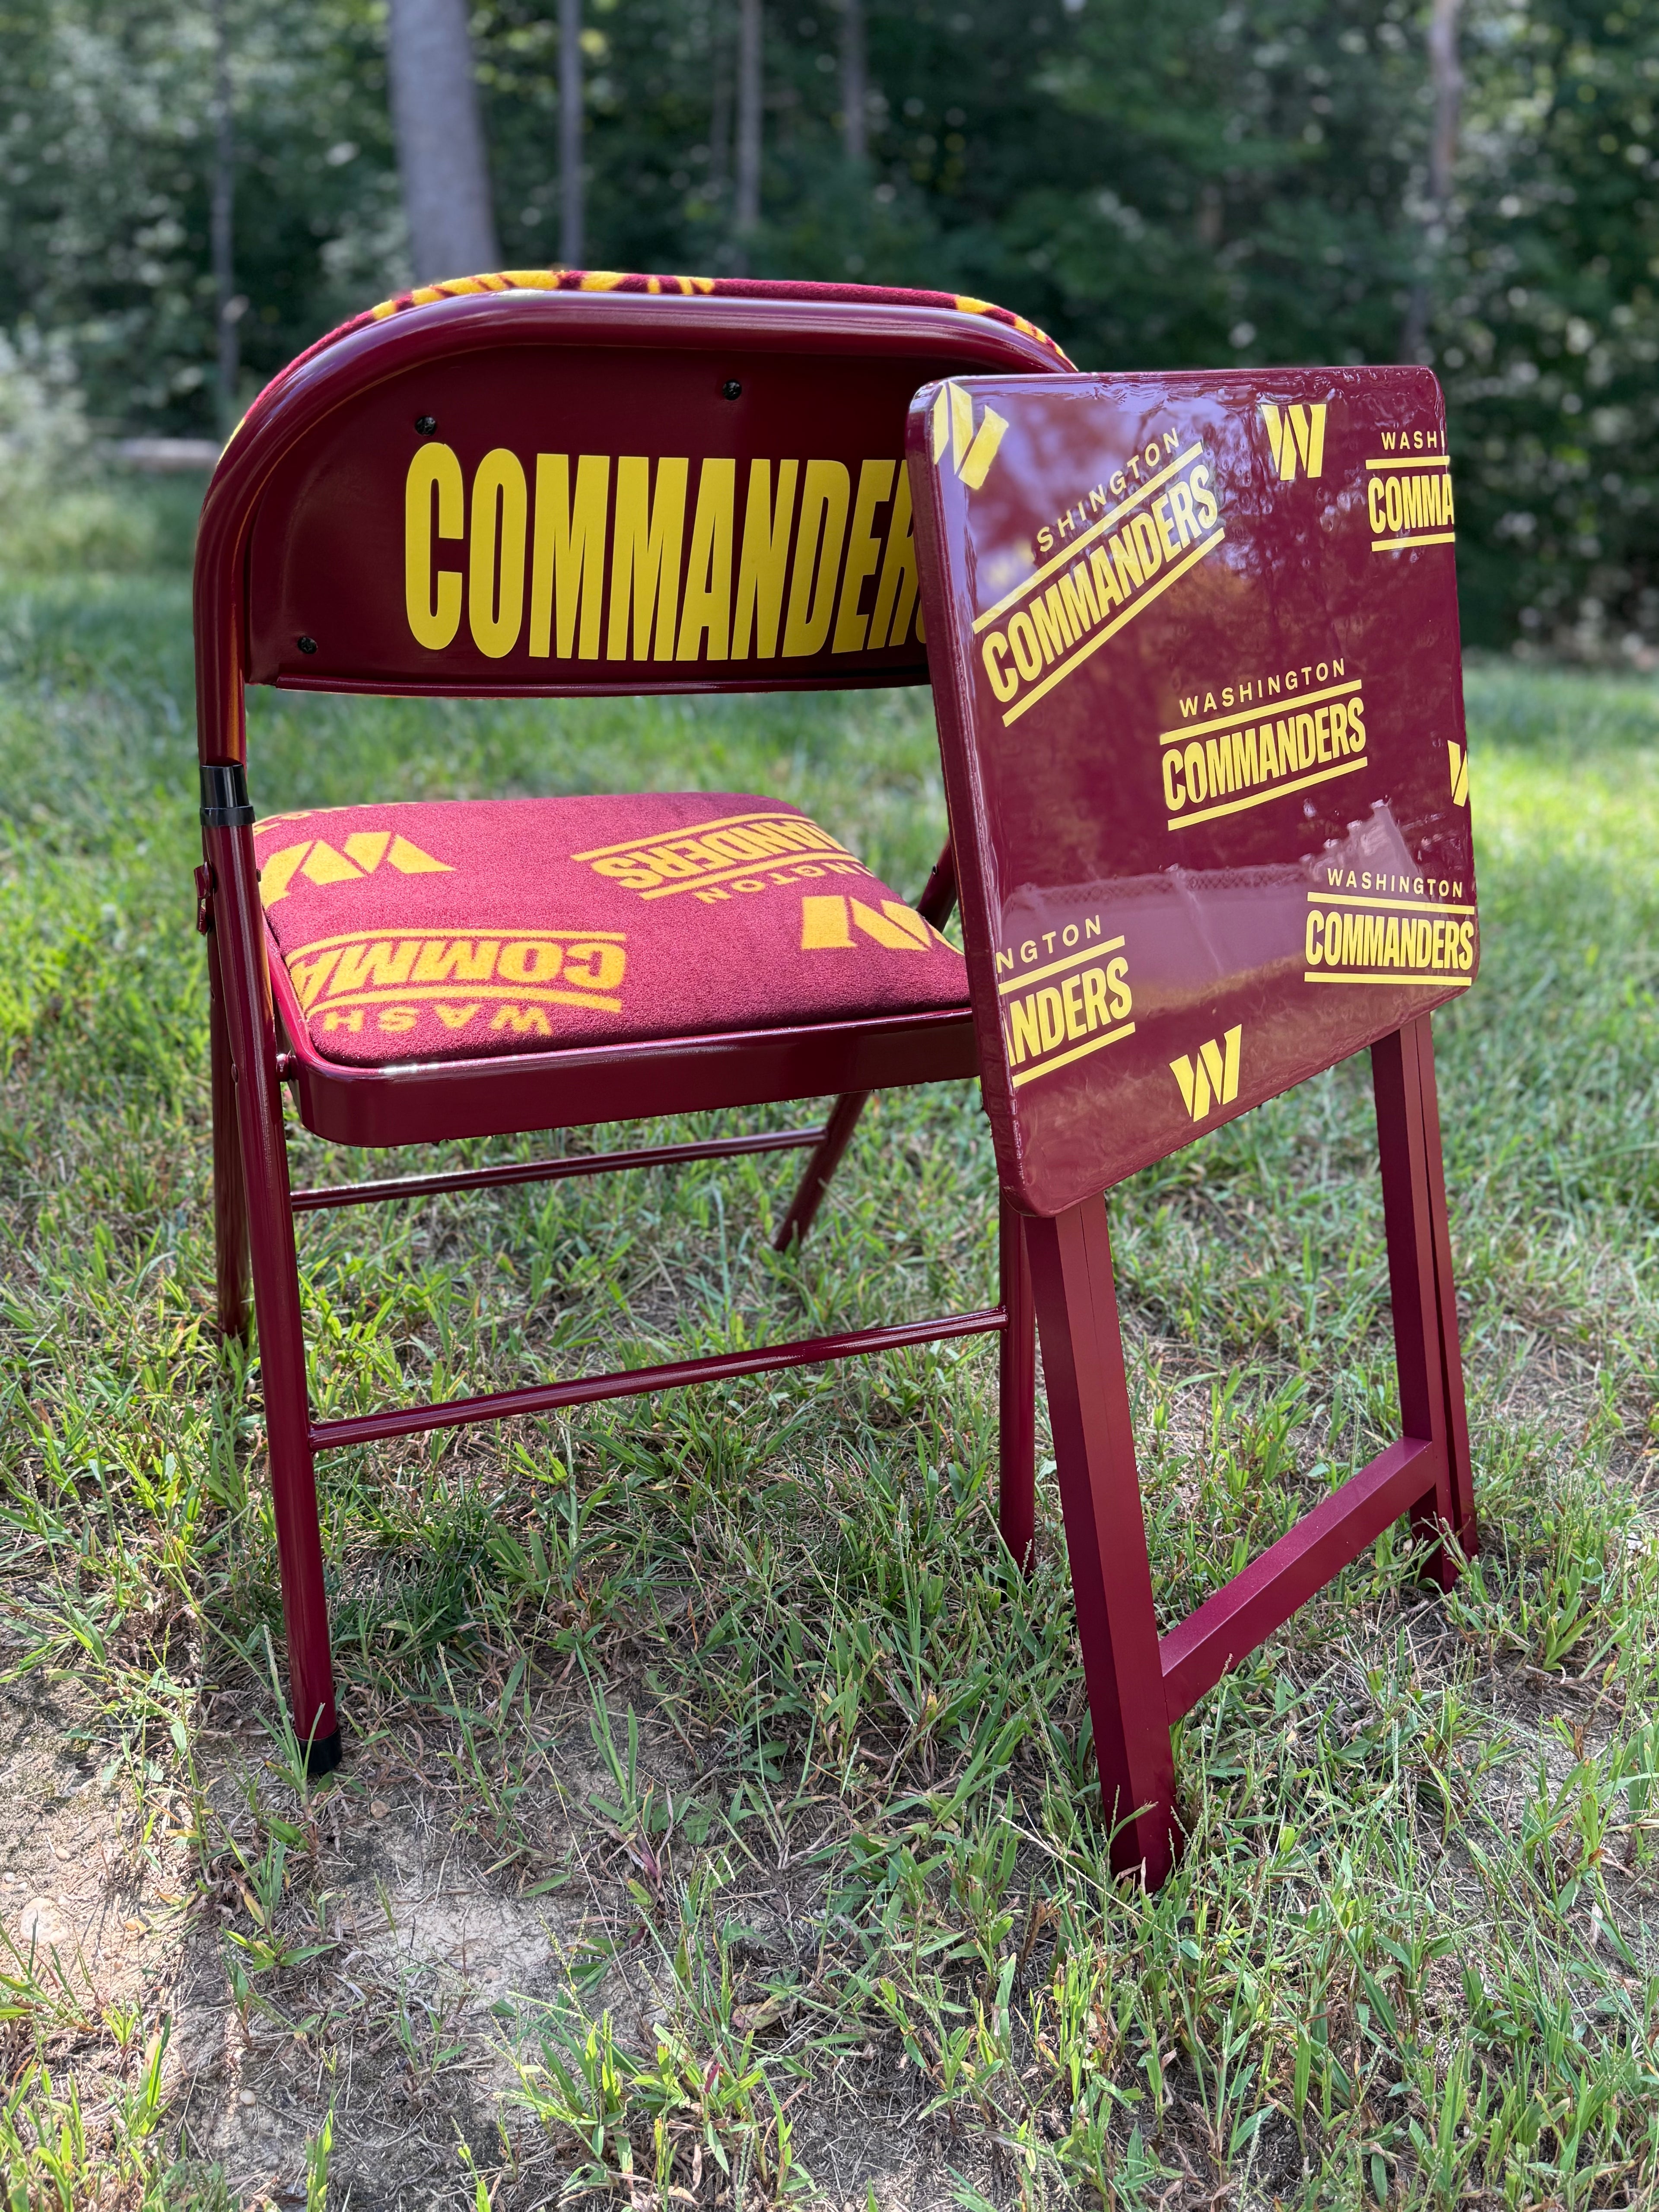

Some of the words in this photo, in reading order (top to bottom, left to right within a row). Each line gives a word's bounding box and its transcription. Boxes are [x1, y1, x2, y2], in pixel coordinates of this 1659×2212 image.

[987, 428, 1180, 588] SHINGTON
[1368, 474, 1454, 534] COMMA
[405, 442, 927, 662] COMMANDER
[982, 464, 1218, 702] COMMANDERS
[1179, 658, 1345, 718] WASHINGTON
[1162, 697, 1366, 811] COMMANDERS
[695, 862, 874, 903] INGTON
[1328, 868, 1463, 898] WASHINGTON
[996, 915, 1101, 973] NGTON
[1306, 910, 1474, 970] COMMANDERS
[324, 1005, 552, 1036] WASH
[1003, 957, 1132, 1067] NDERS
